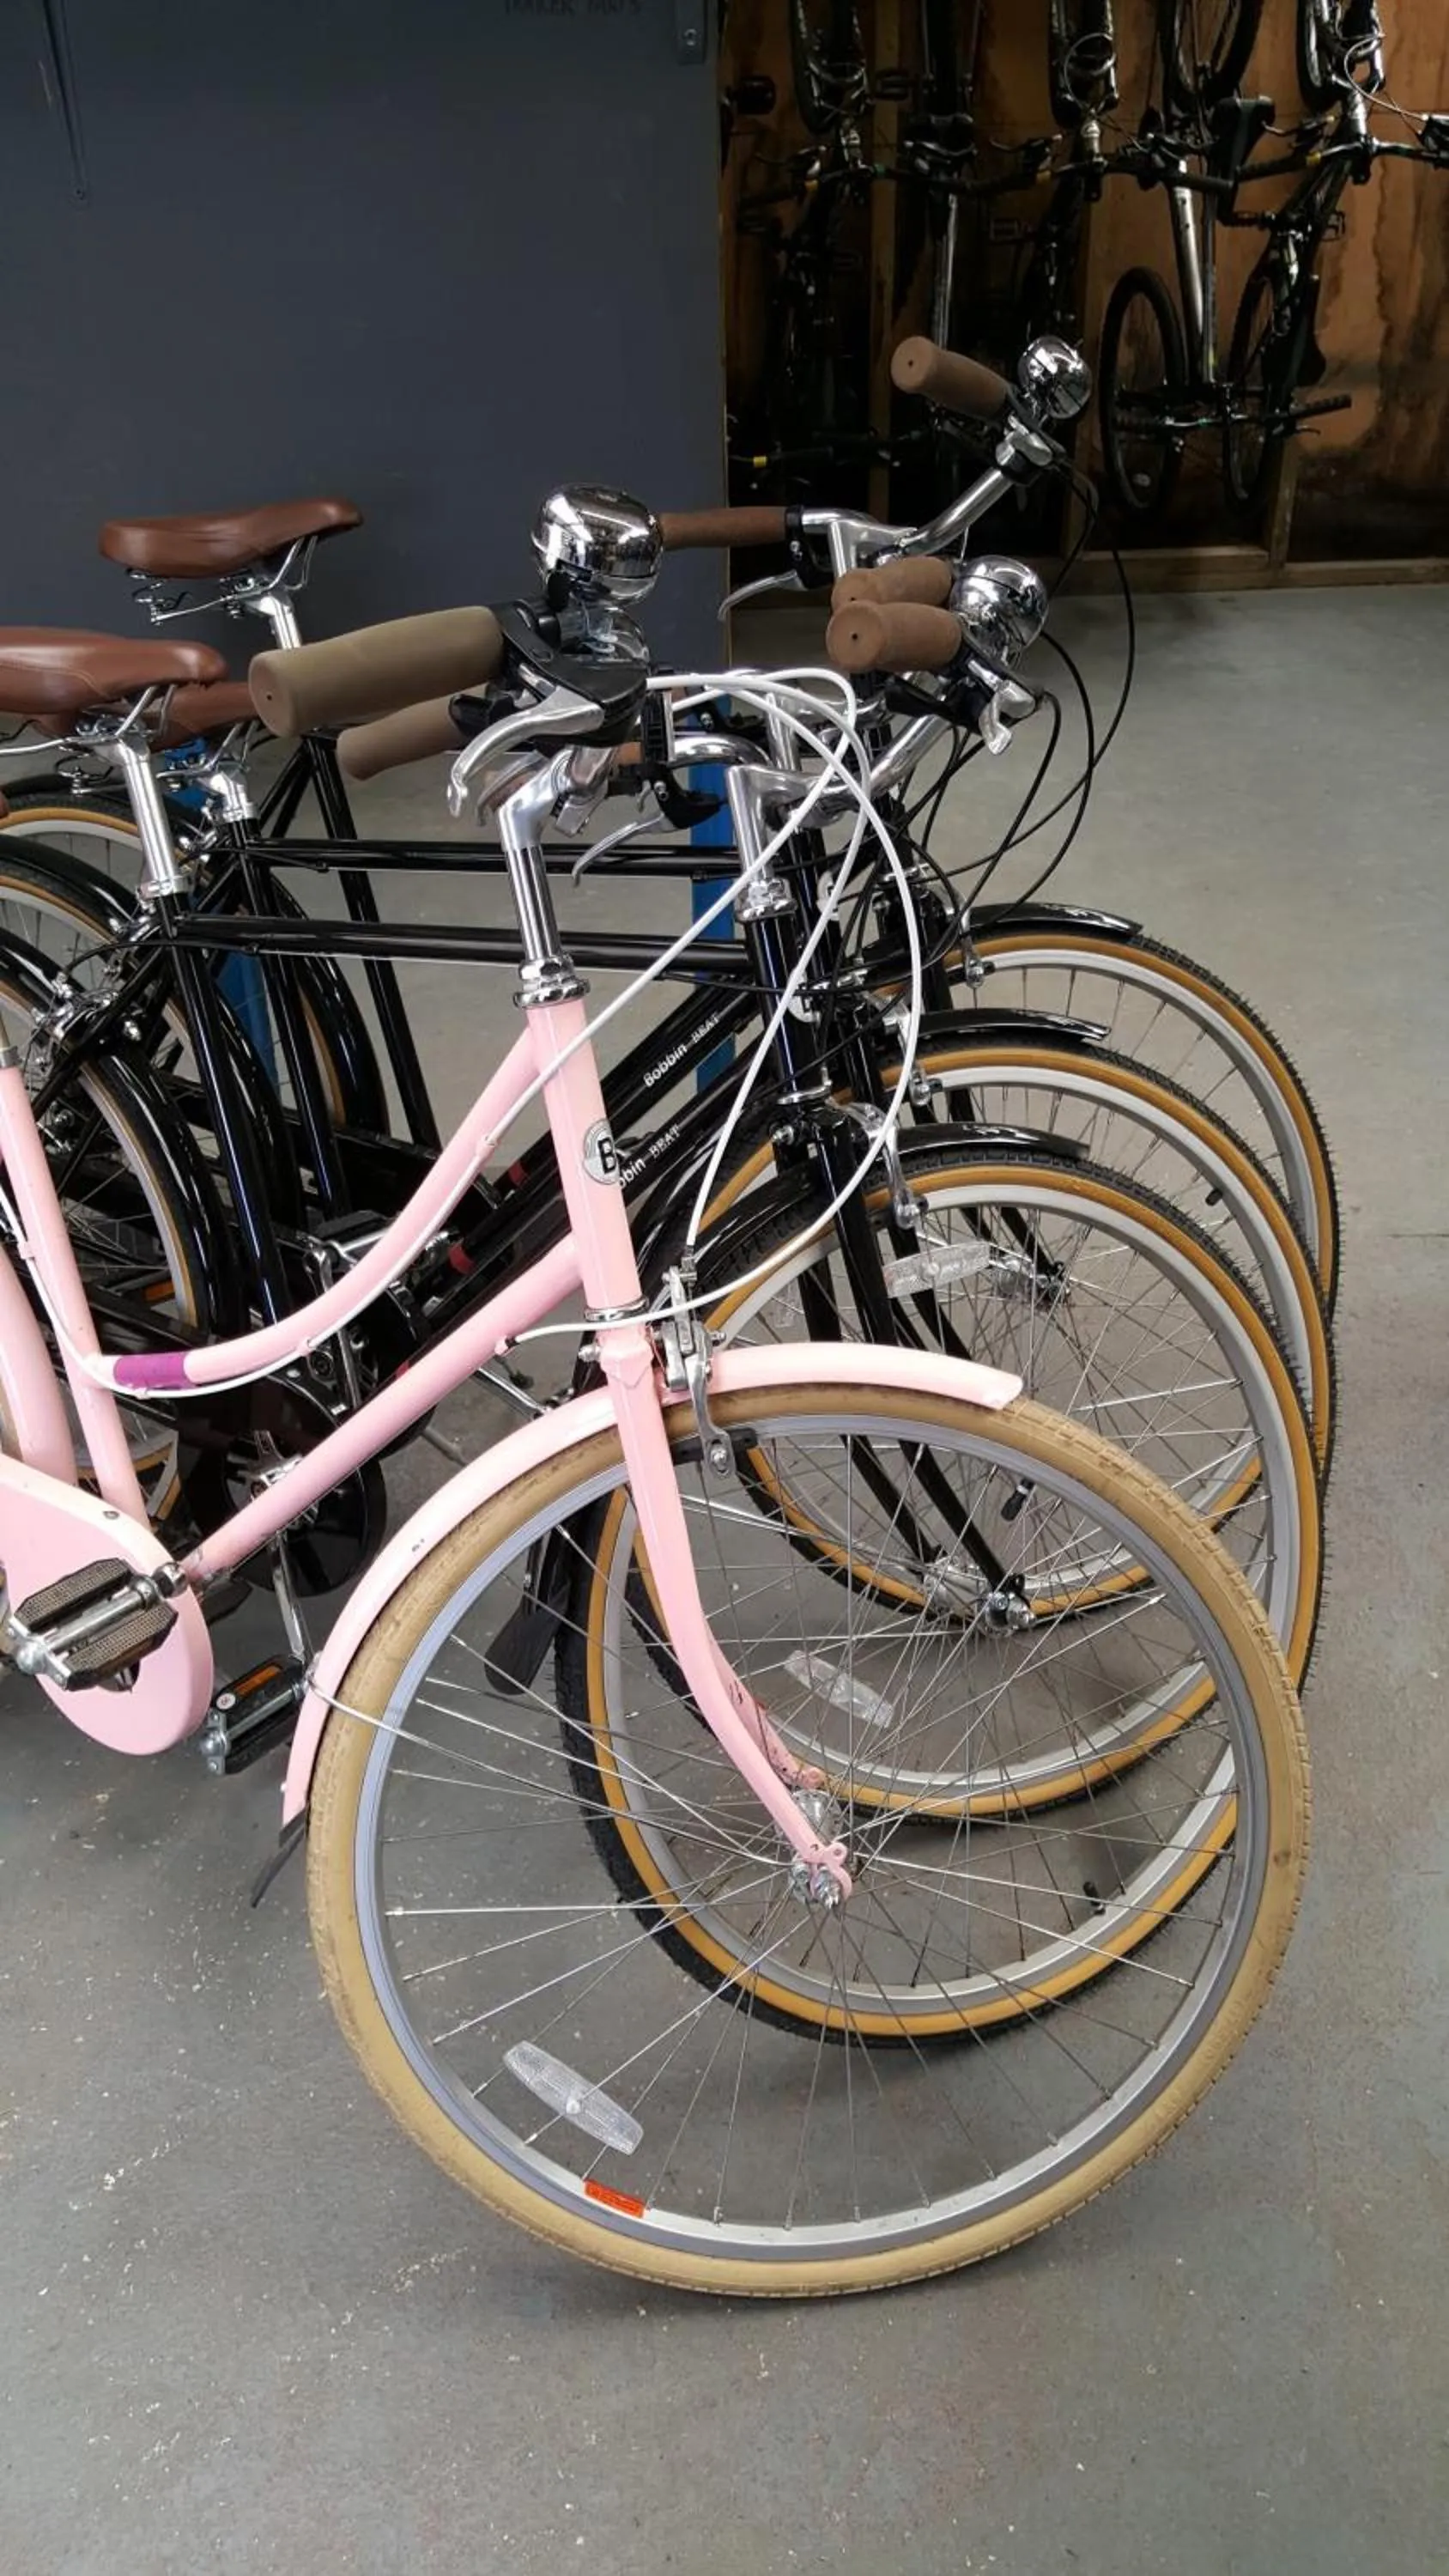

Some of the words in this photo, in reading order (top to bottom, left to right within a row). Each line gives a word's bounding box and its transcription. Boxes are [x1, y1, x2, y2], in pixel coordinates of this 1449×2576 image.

[643, 1043, 688, 1087] Bobbin
[597, 1136, 616, 1176] B
[648, 1123, 681, 1159] BEAT
